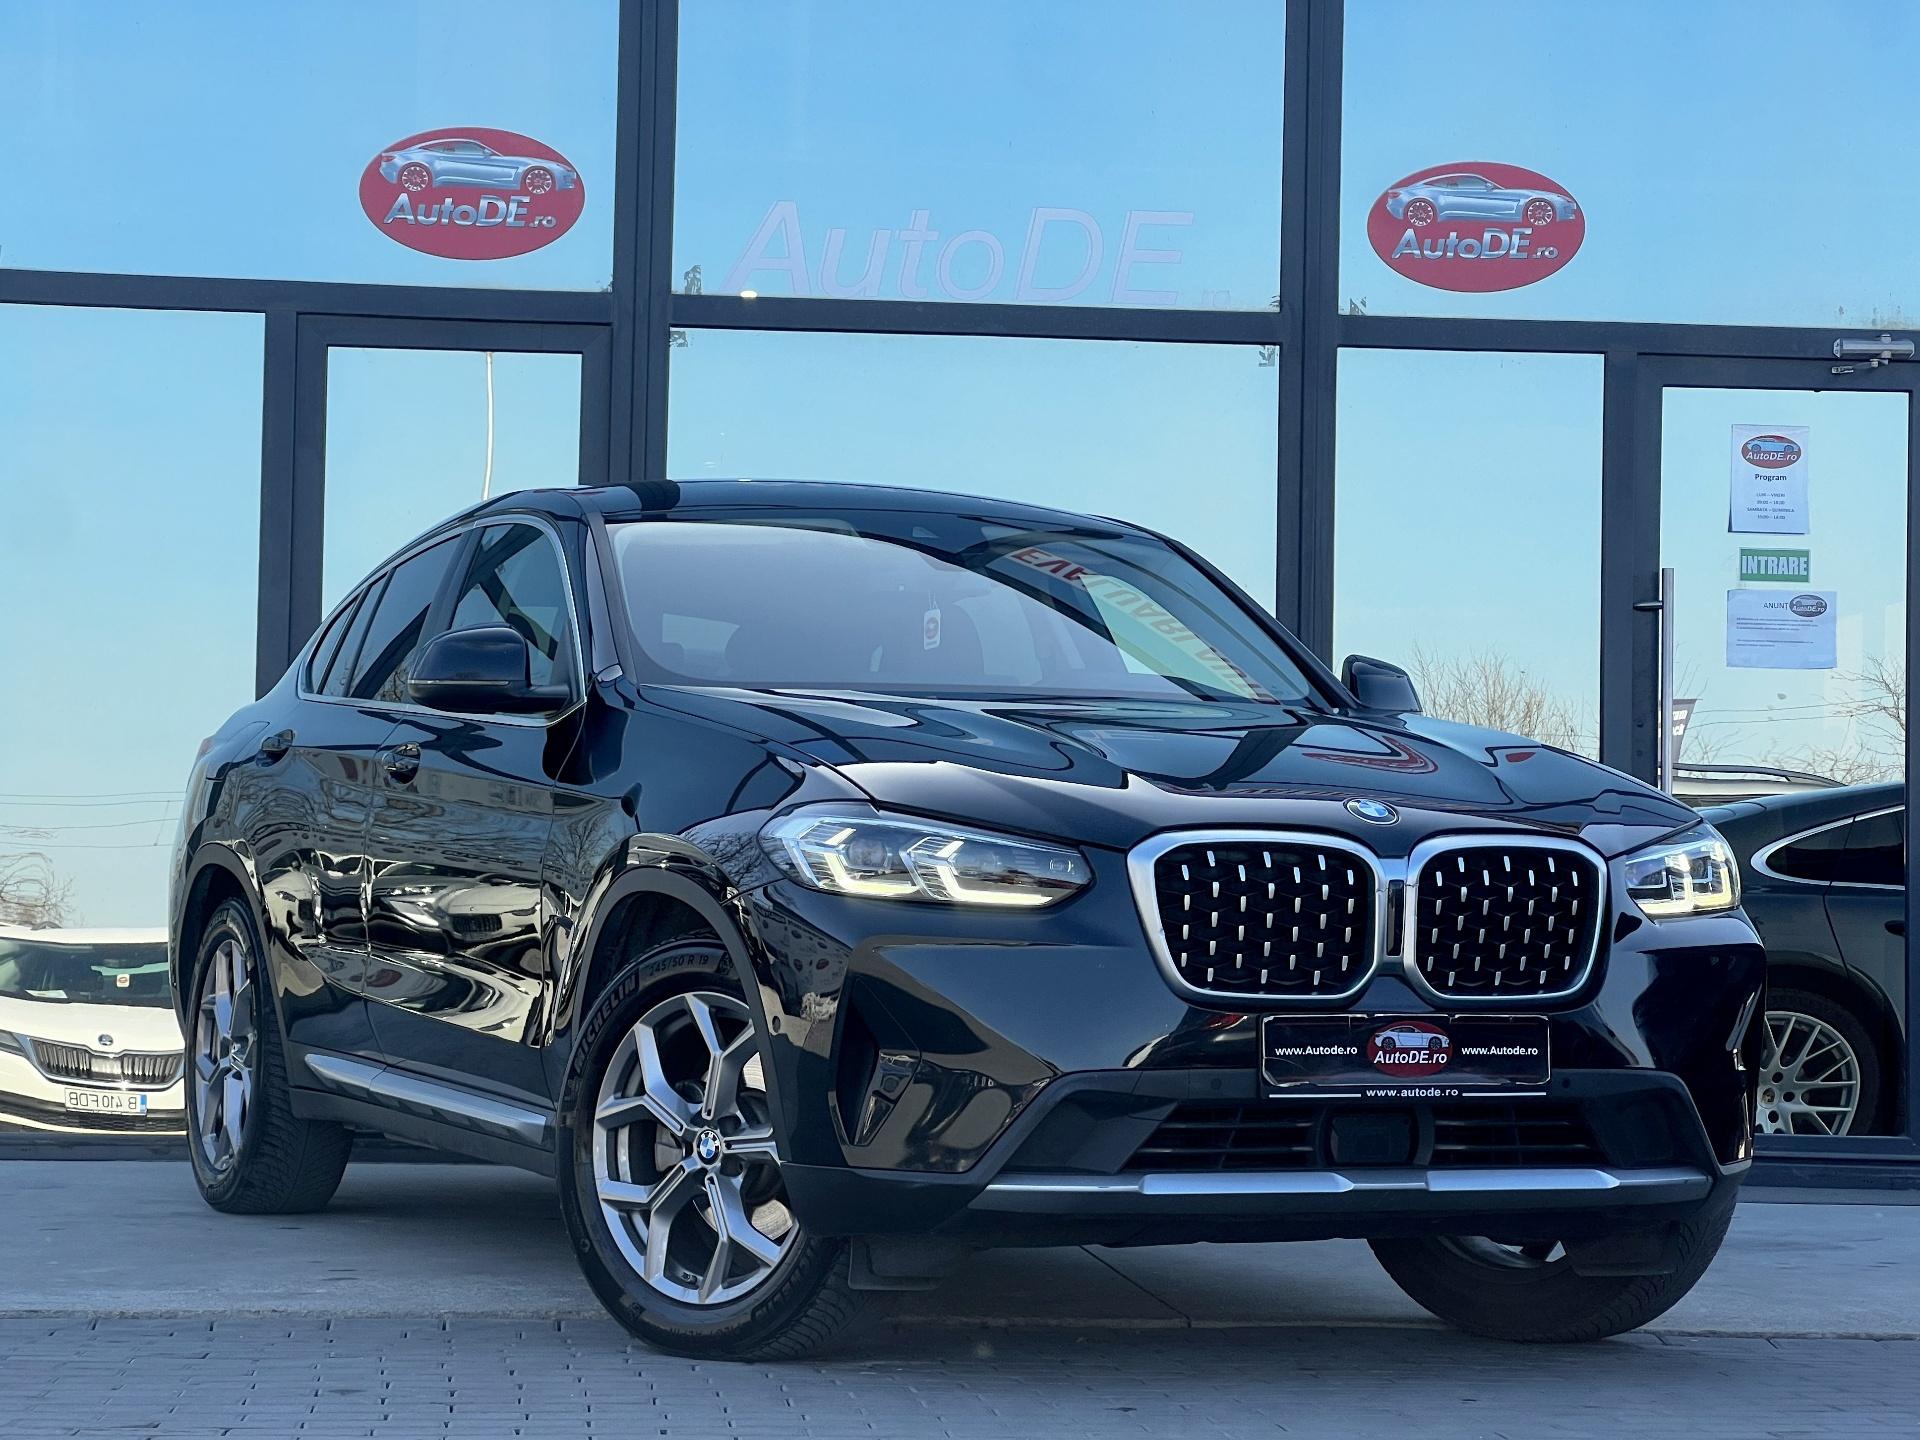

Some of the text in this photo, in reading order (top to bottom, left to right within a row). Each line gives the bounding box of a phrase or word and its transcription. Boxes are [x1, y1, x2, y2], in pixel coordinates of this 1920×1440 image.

[720, 199, 1195, 306] AutoDE
[1745, 451, 1798, 461] AutoDE.ro
[1754, 473, 1787, 482] Program
[1741, 555, 1808, 576] INTRARE
[573, 974, 637, 1074] MICHELIN
[1275, 1045, 1358, 1055] www.Autode.ro
[1461, 1045, 1539, 1056] www.Autode.ro
[1373, 1050, 1448, 1064] AutoDE.ro
[1366, 1087, 1459, 1097] www.autode.ro
